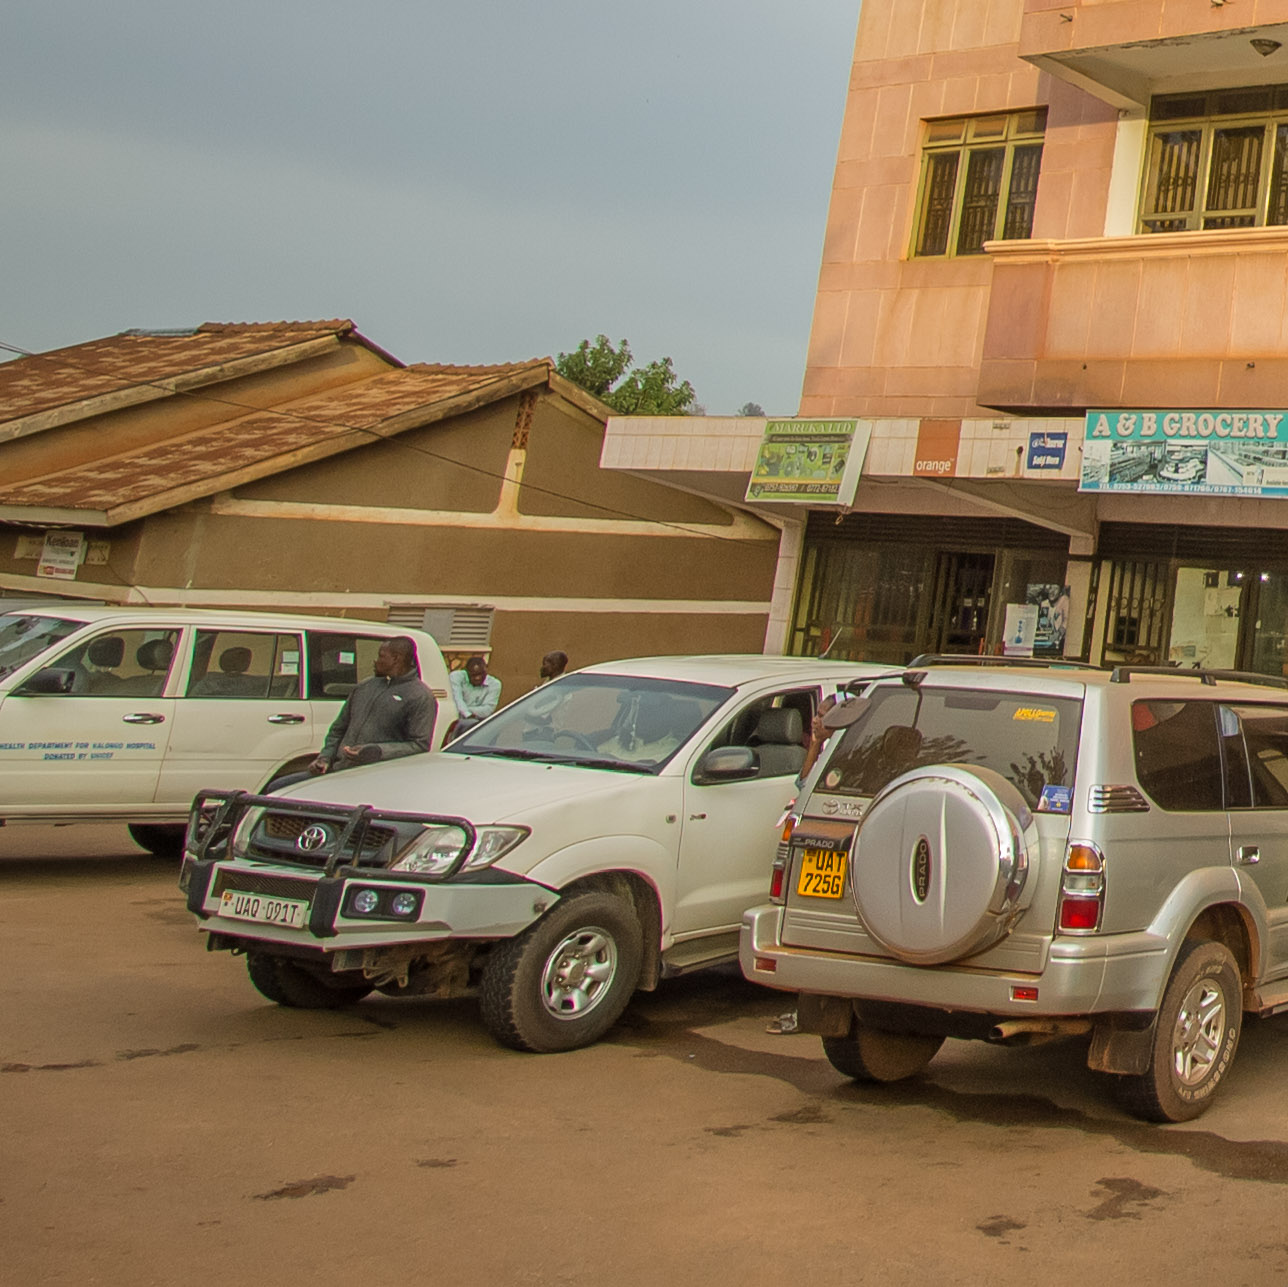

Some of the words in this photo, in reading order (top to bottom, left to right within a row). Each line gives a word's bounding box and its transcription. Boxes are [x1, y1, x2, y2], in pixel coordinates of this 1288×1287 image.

[1092, 415, 1111, 437] A
[1116, 413, 1137, 437] &
[1140, 413, 1157, 437] B
[1162, 413, 1283, 439] GROCERY
[916, 460, 951, 474] orange
[28, 742, 73, 750] DEPARTMENT
[804, 838, 834, 849] PRADO
[815, 850, 845, 872] UAT
[918, 842, 928, 897] PRADO
[803, 873, 842, 895] 725G
[235, 896, 260, 918] UAQ
[265, 901, 299, 924] 091T
